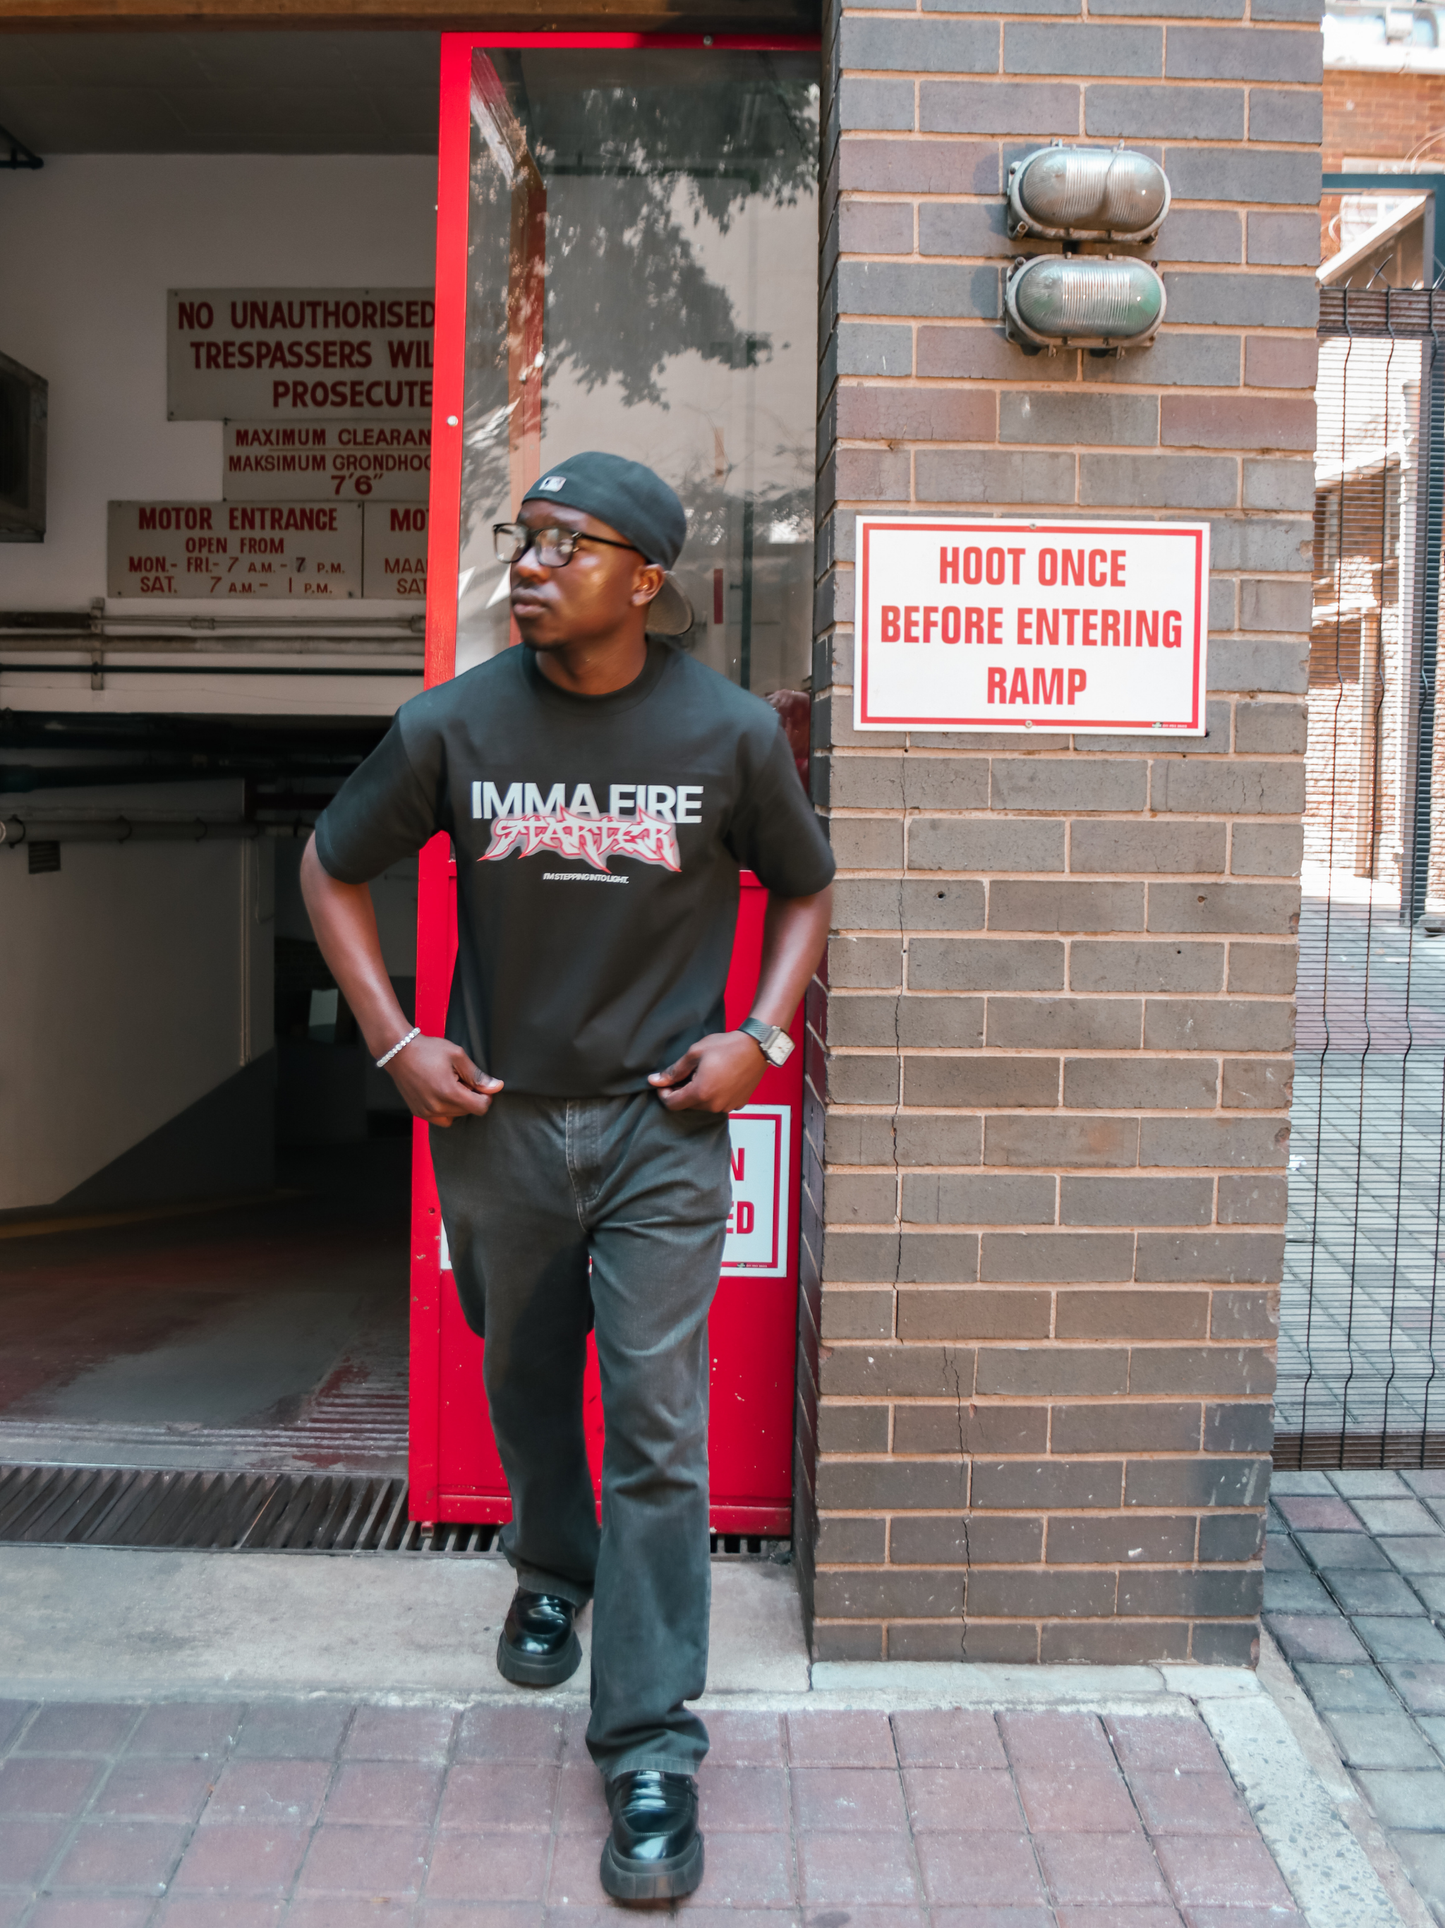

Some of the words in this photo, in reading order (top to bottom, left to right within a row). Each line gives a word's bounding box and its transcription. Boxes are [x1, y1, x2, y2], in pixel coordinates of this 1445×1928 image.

[178, 301, 214, 330] NO
[230, 300, 435, 329] UNAUTHORISED
[190, 340, 373, 370] TRESPASSERS
[272, 380, 433, 408] PROSECUTE
[235, 428, 327, 447] MAXIMUM
[228, 454, 327, 472] MAKSIMUM
[138, 507, 214, 531] MOTOR
[228, 507, 338, 532] ENTRANCE
[390, 507, 429, 532] MO
[185, 537, 228, 555] OPEN
[240, 537, 285, 555] FROM
[227, 557, 239, 573] 7
[317, 562, 346, 574] P.M.
[939, 546, 1026, 585] HOOT
[1038, 547, 1127, 587] ONCE
[140, 576, 178, 594] SAT.
[209, 576, 222, 594] 7
[304, 582, 333, 595] P.M.
[881, 605, 1004, 645] BEFORE
[1017, 607, 1182, 648] ENTERING
[987, 666, 1088, 705] RAMP
[471, 780, 600, 820] IMMA
[609, 783, 704, 824] FIRE
